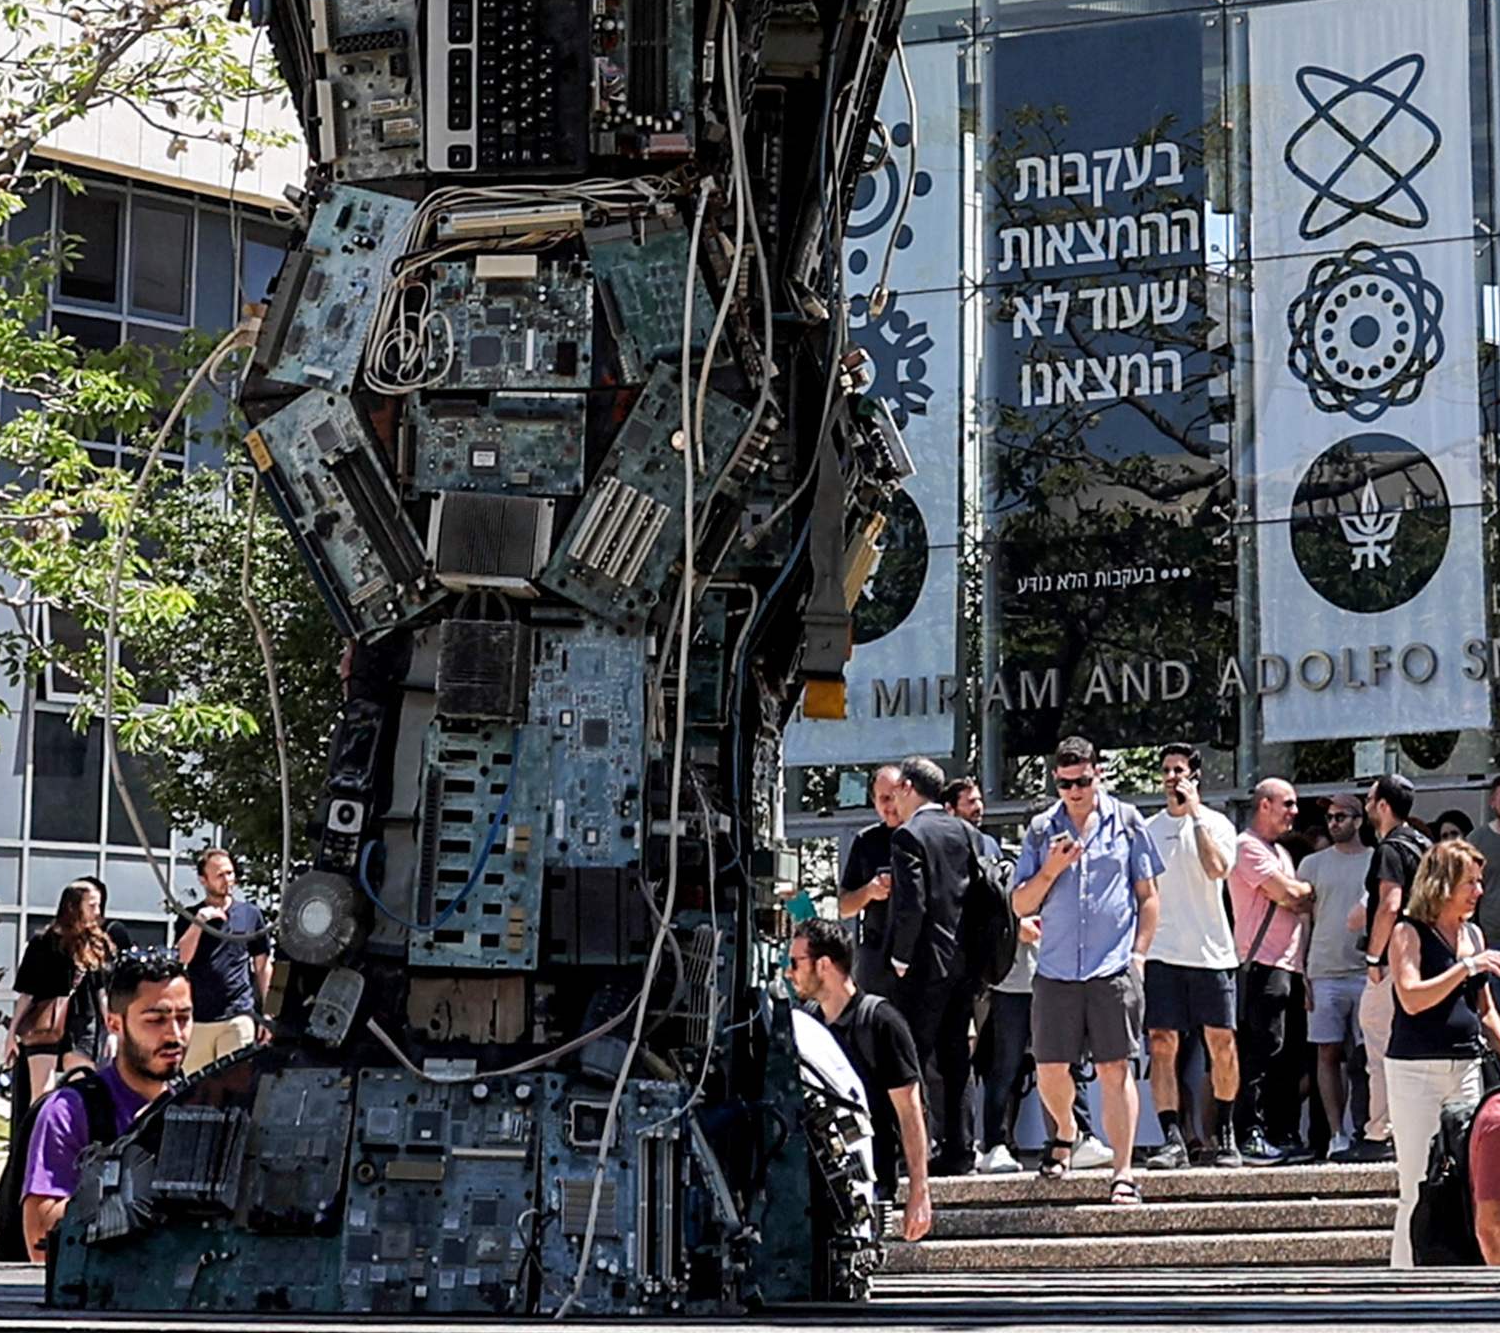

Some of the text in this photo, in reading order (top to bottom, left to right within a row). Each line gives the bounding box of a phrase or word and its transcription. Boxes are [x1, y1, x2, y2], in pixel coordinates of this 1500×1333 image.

[1013, 141, 1184, 208] בעקבות
[997, 208, 1200, 272] ההמצאות
[1012, 275, 1189, 339] שעוד לא
[1020, 350, 1183, 407] המצאנו
[1017, 567, 1156, 595] בעקבות הלא נודע
[872, 668, 1059, 719] MIRIAM
[1085, 659, 1192, 710] AND
[1219, 643, 1440, 697] ADOLFO
